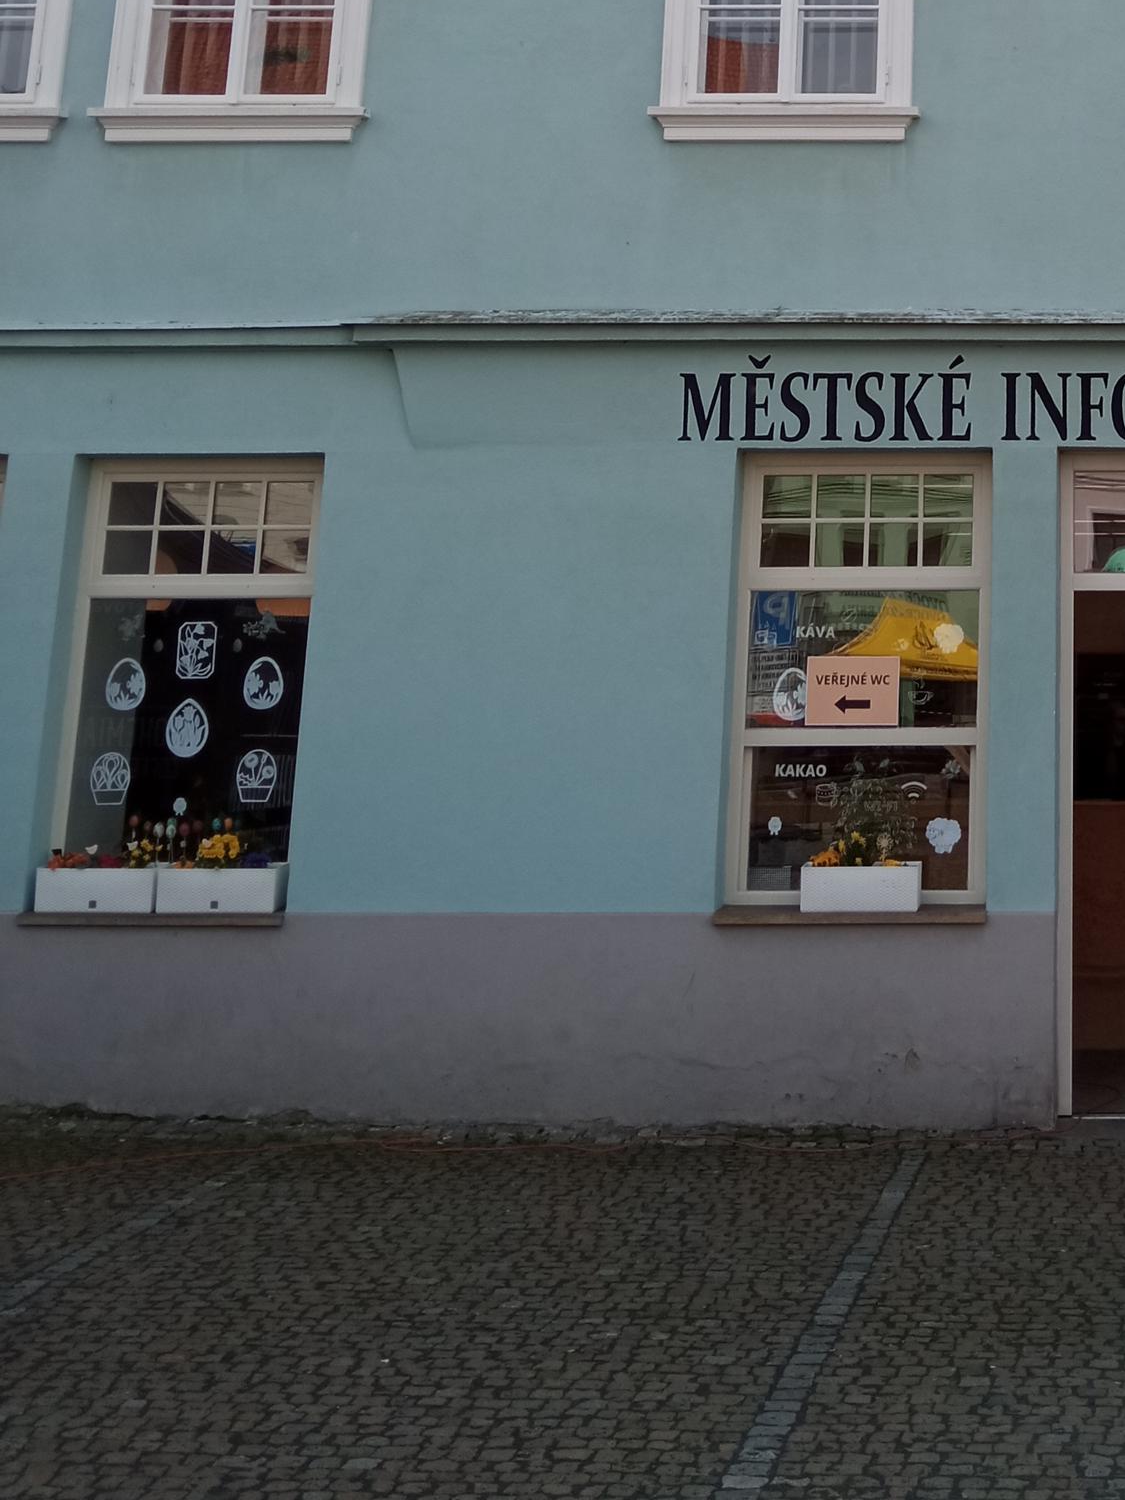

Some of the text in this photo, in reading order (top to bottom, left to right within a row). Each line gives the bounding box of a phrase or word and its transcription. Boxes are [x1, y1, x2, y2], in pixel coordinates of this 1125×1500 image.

[677, 354, 972, 442] MĚSTSKÉ
[795, 623, 836, 639] KÁVA
[815, 671, 868, 688] VEŘEJNÉ
[869, 673, 891, 686] WC
[774, 763, 827, 778] KAKAO
